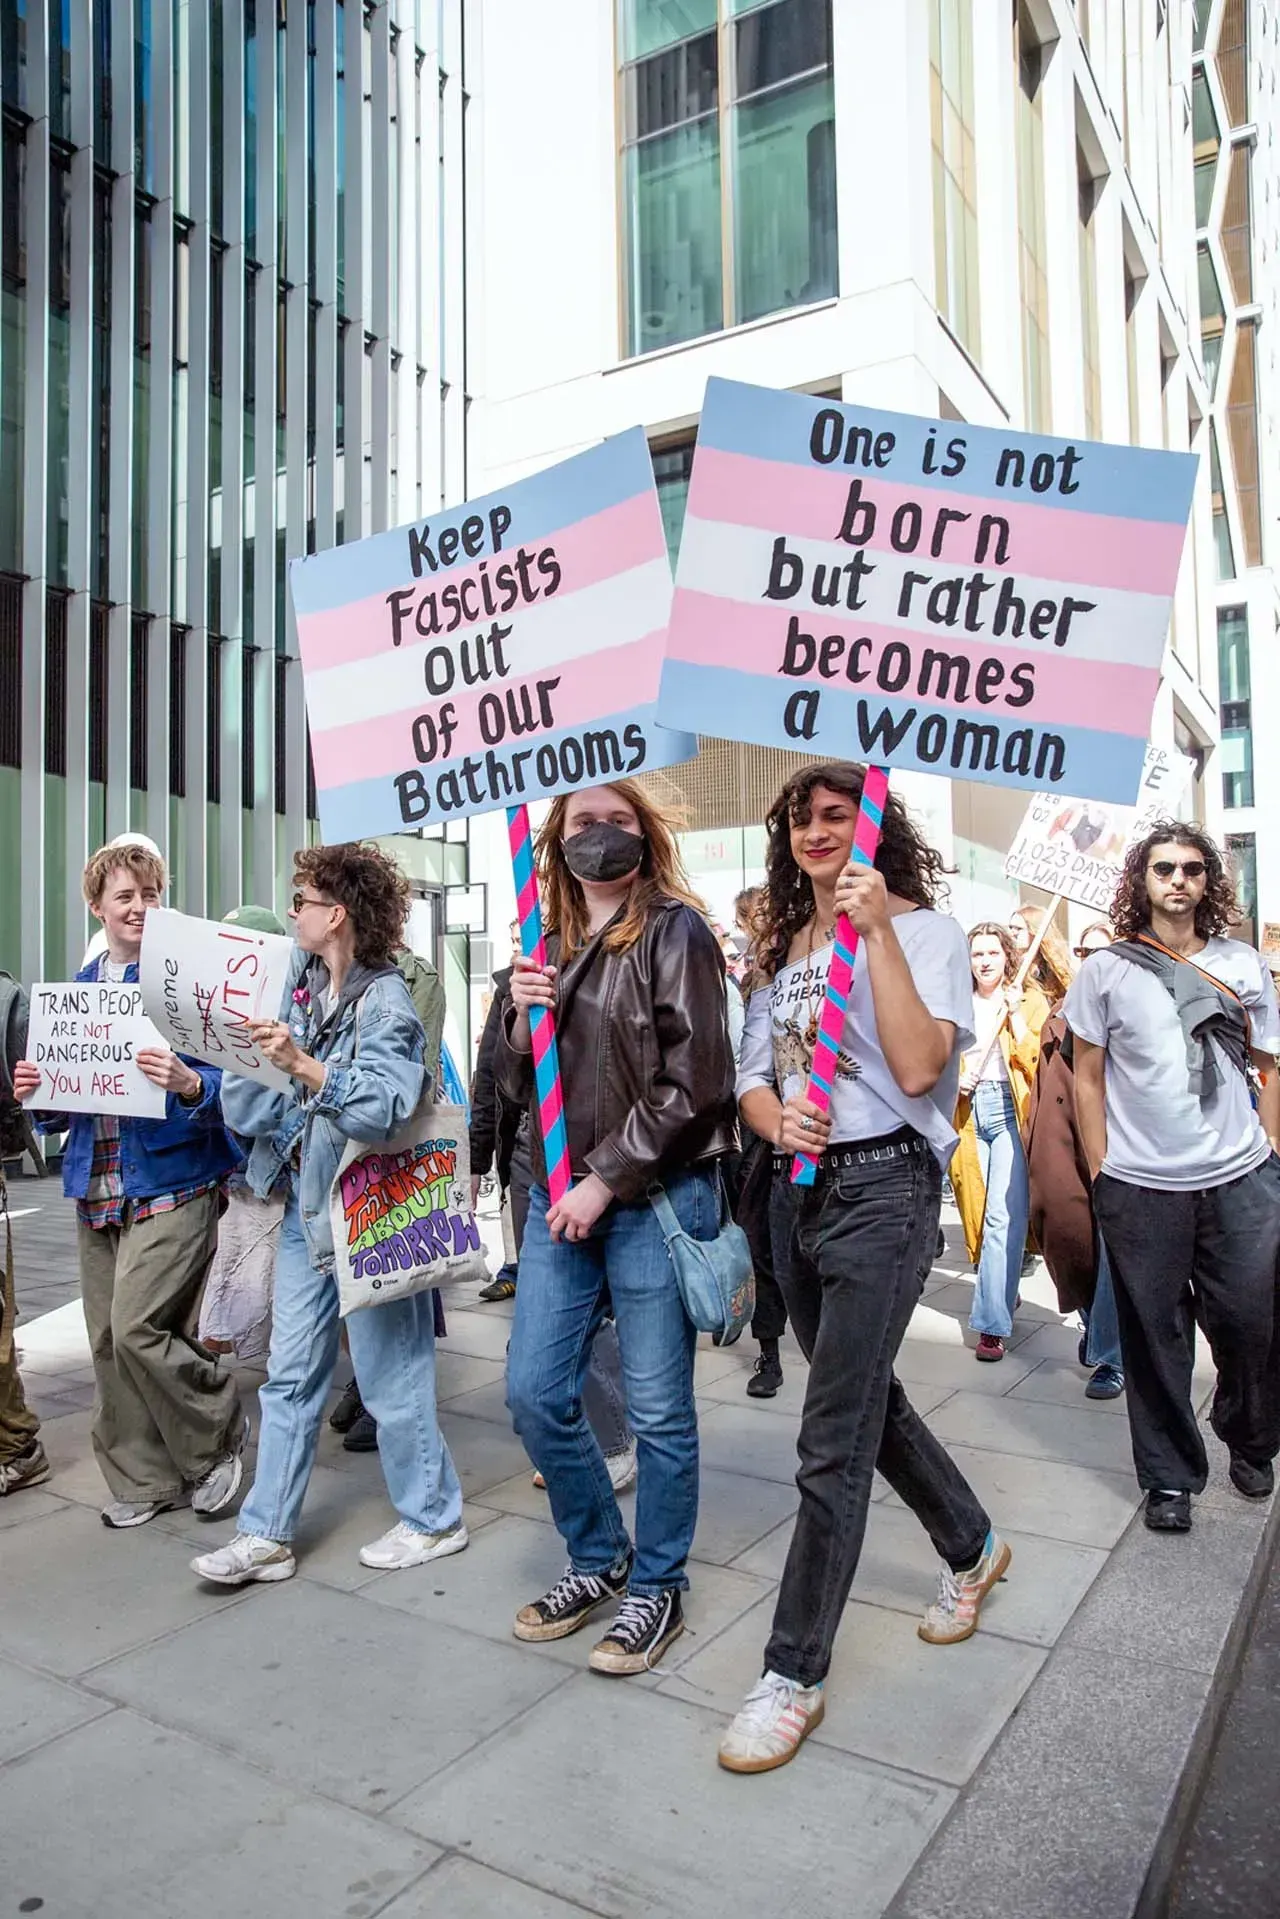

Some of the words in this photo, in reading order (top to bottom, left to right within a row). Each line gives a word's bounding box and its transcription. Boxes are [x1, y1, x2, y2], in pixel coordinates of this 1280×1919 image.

[809, 408, 896, 469] One
[922, 427, 967, 477] is
[995, 446, 1083, 495] not
[408, 505, 513, 578] Keep
[834, 479, 1010, 565] born
[385, 547, 562, 647] Fascists
[762, 536, 877, 611] but
[897, 569, 1097, 648] rather
[424, 623, 513, 696] out
[778, 616, 1036, 708] becomes
[411, 703, 458, 763] of
[478, 676, 561, 745] our
[783, 690, 820, 740] a
[393, 723, 647, 824] Bathrooms
[1147, 746, 1168, 764] ER
[1032, 861, 1081, 895] WAIT
[38, 991, 90, 1016] TRANS
[99, 988, 148, 1016] PEOP
[50, 1021, 77, 1037] ARE
[83, 1021, 113, 1040] NOT
[218, 932, 265, 1069] CUNTS!
[36, 1041, 133, 1063] DANGEROUS
[44, 1068, 81, 1100] YOU
[91, 1071, 129, 1097] ARE.
[349, 1175, 455, 1256] ABOUT
[349, 1209, 481, 1280] TOMORROW
